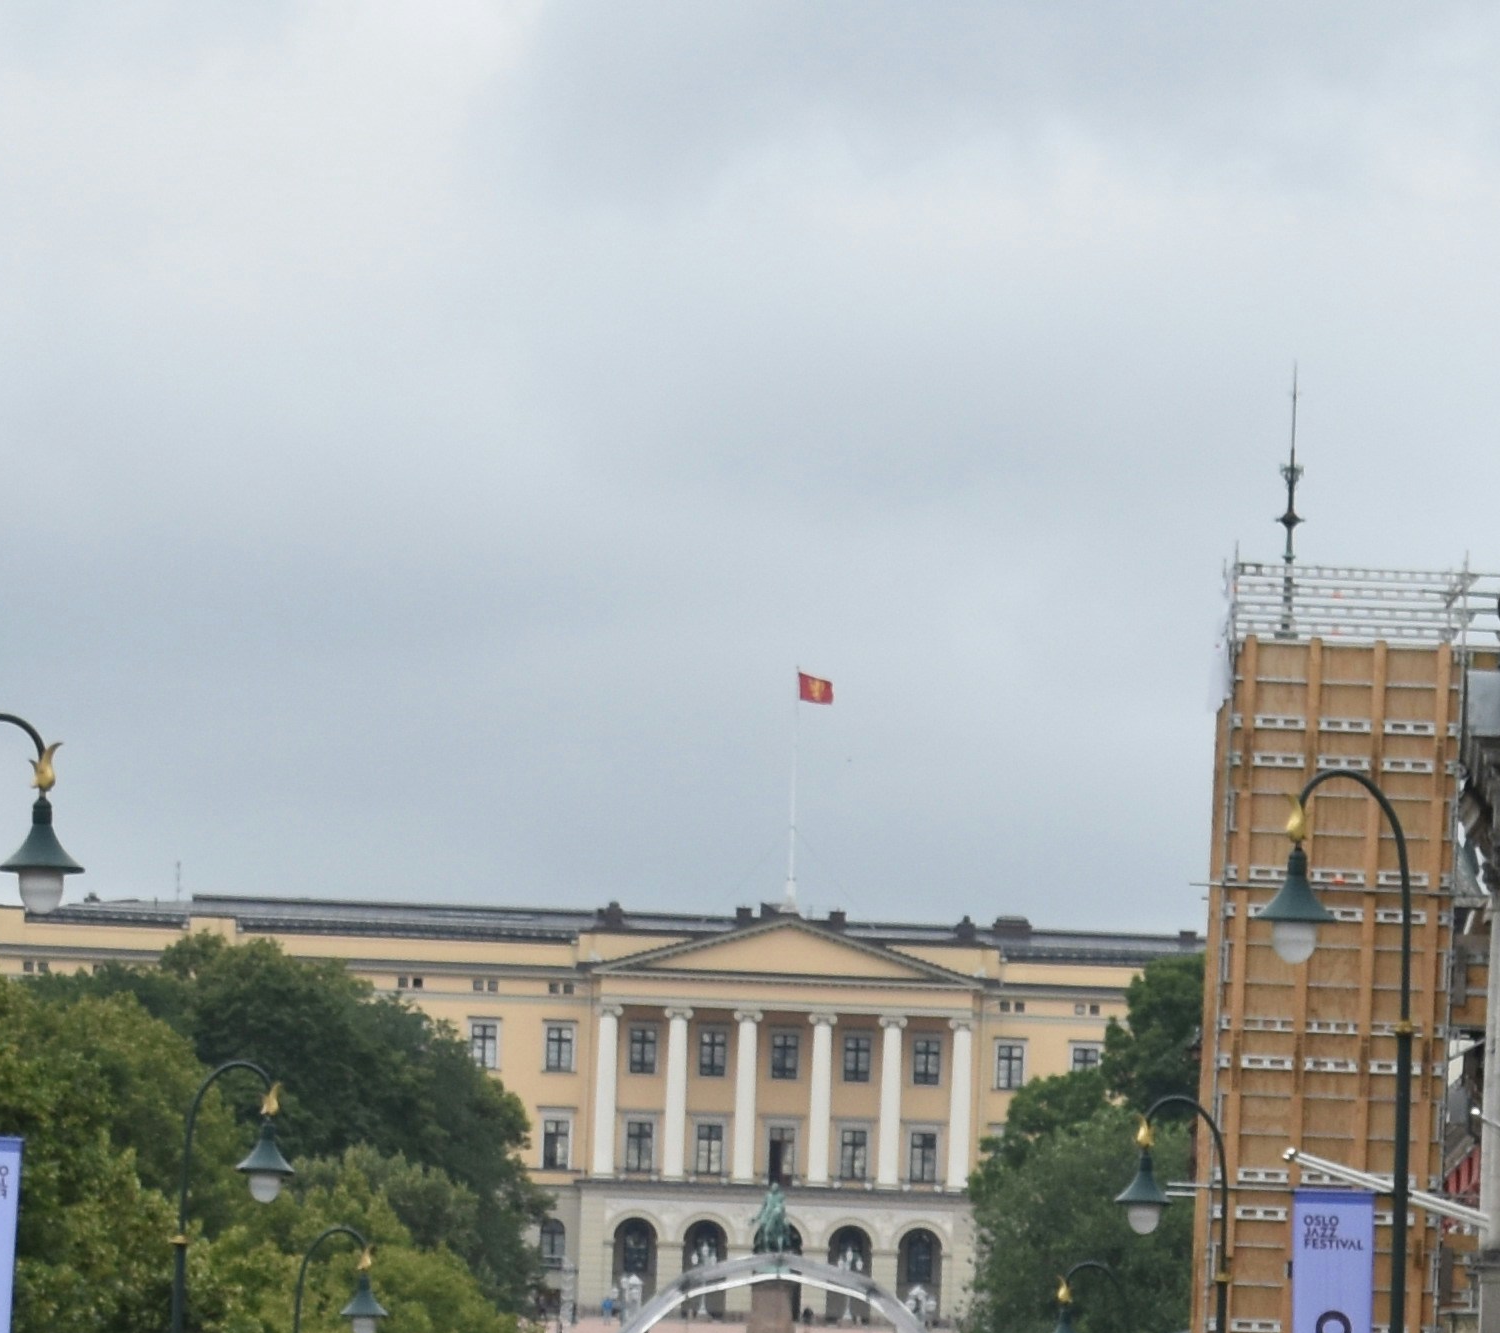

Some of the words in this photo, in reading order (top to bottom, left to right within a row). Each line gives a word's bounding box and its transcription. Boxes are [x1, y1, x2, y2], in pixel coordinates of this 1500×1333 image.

[1303, 1214, 1339, 1226] OSLO
[1304, 1226, 1337, 1238] JAZZ
[1304, 1238, 1364, 1250] FESTIVAL
